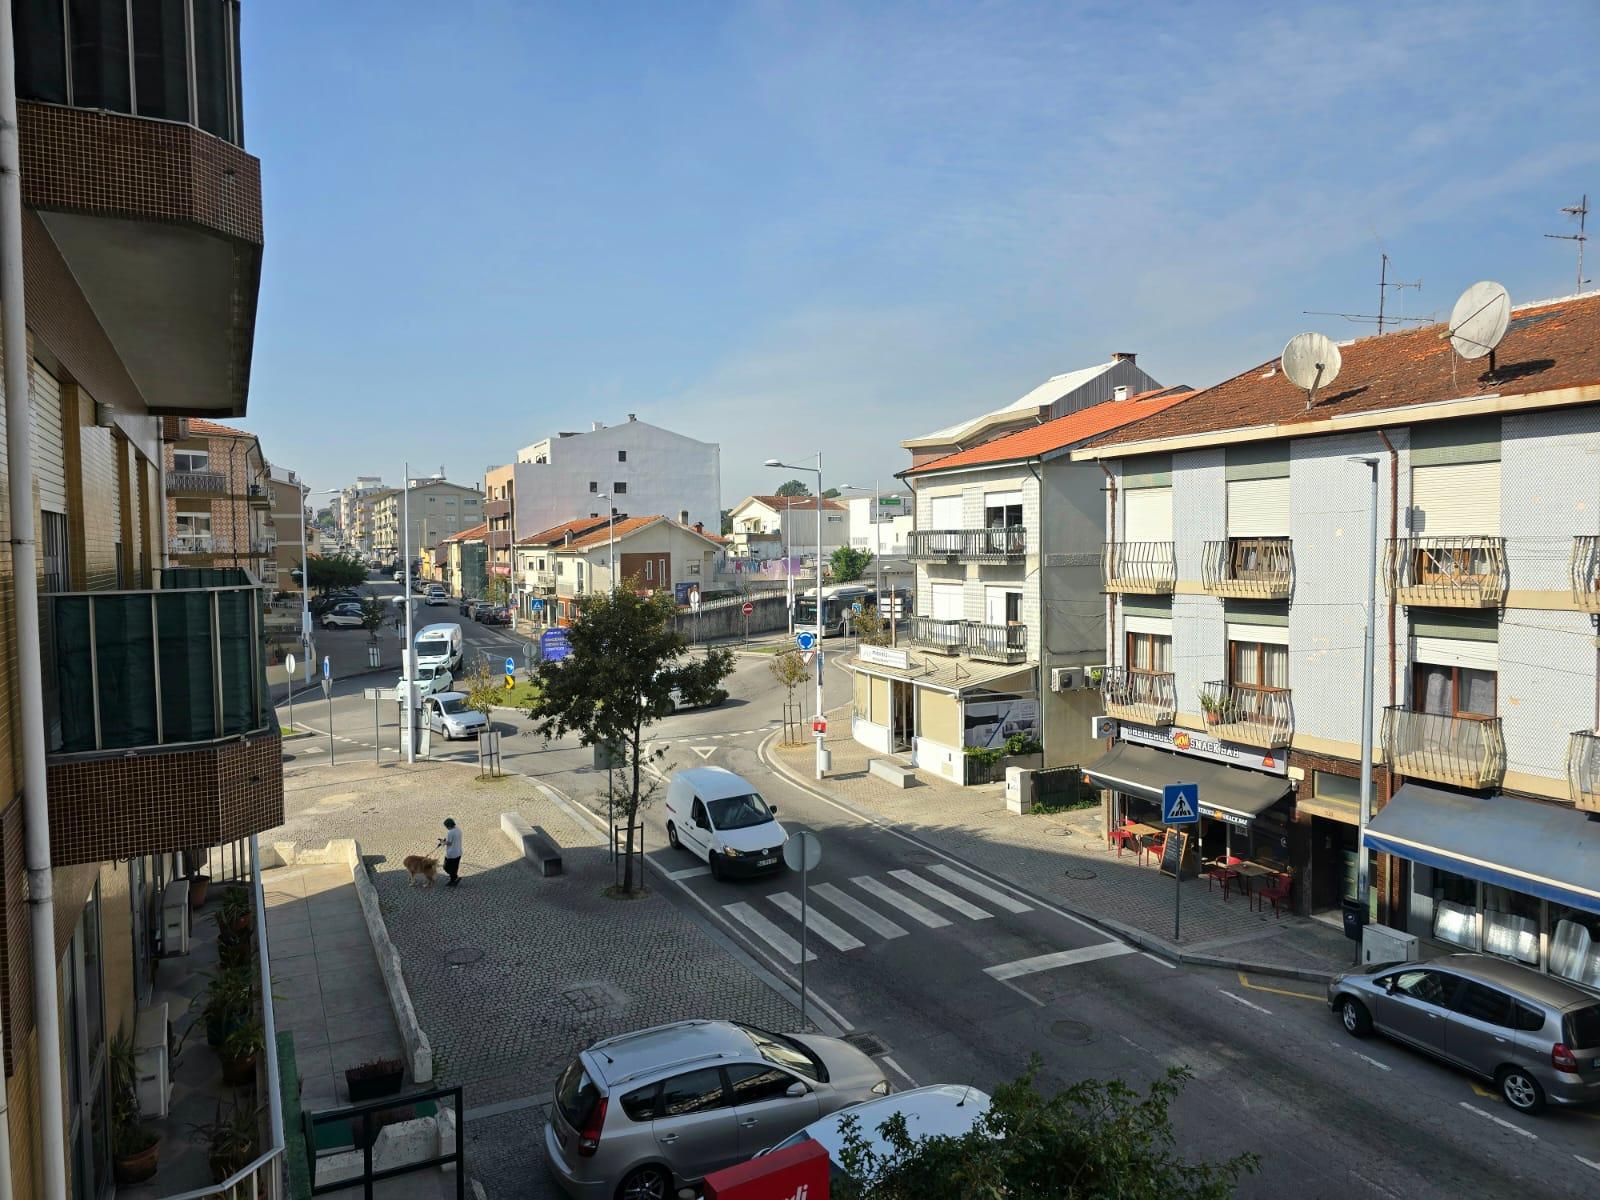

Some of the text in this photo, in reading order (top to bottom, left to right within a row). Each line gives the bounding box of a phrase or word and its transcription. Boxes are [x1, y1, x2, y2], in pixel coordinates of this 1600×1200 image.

[1143, 729, 1174, 744] HEROES
[1190, 738, 1221, 754] SNACK
[1221, 744, 1239, 758] BAR
